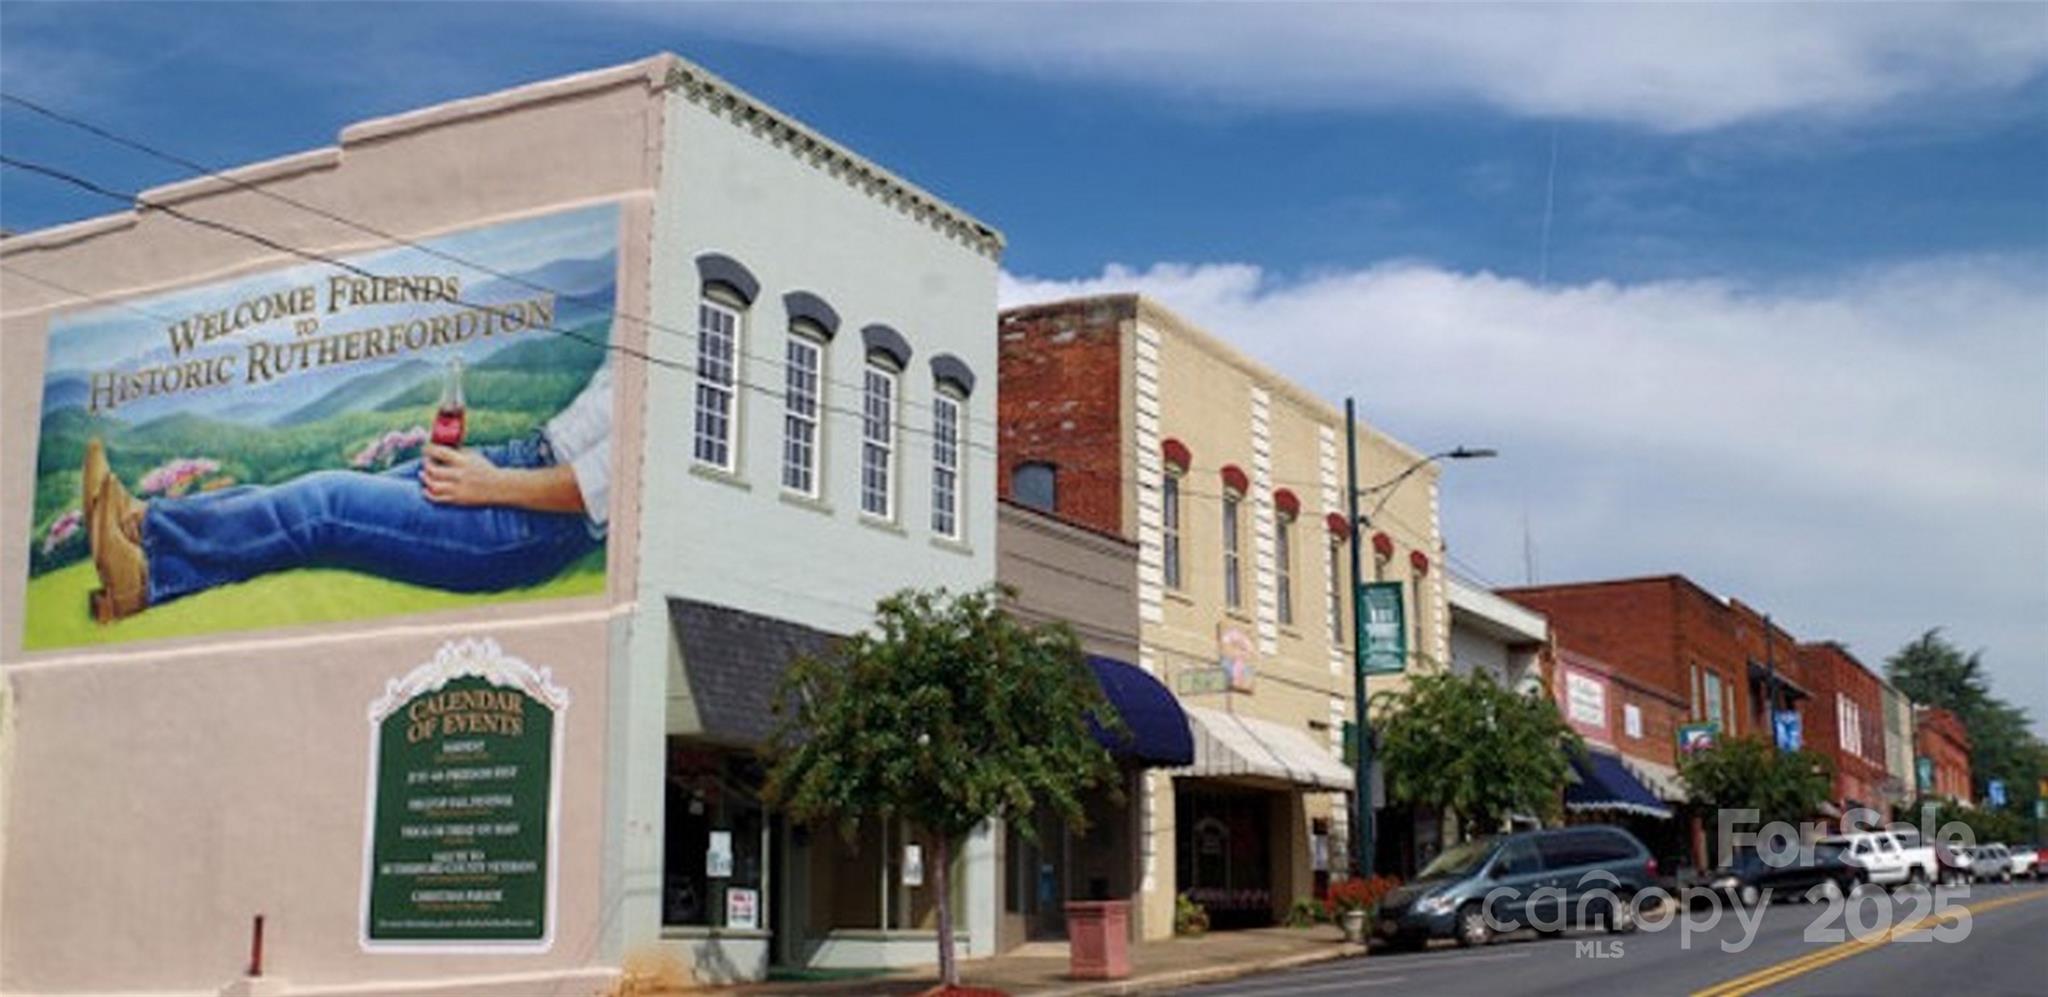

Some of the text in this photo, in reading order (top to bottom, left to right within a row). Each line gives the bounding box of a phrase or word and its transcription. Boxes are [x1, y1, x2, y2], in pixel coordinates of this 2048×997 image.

[166, 275, 460, 358] WELCOME FRIENDS
[295, 318, 319, 338] TO
[87, 293, 557, 414] HISTORIC RUTHERFORDTON
[410, 689, 524, 721] CALENDAR
[407, 713, 524, 743] OF EVENTS
